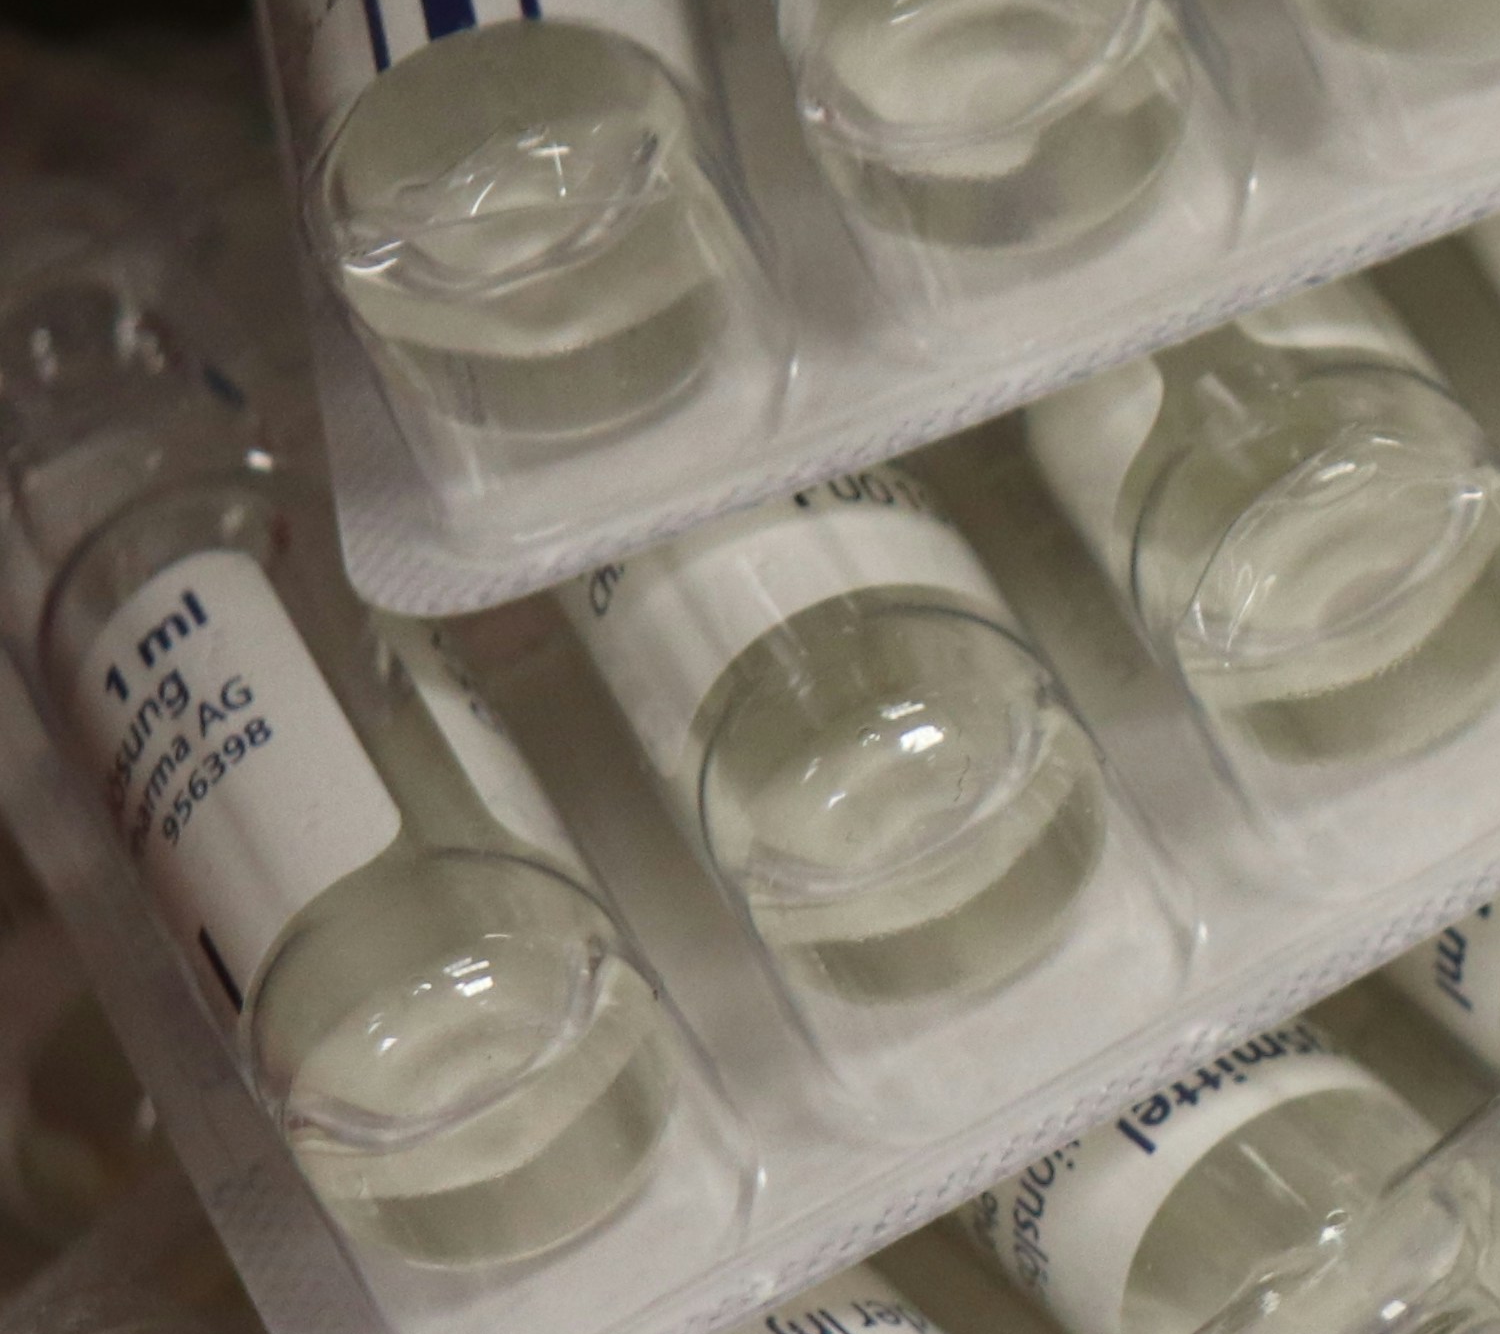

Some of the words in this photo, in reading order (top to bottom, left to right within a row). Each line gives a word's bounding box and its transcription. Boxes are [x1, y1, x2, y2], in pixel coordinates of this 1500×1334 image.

[104, 664, 131, 703] 1
[136, 588, 211, 669] ml
[198, 672, 256, 738] AG
[160, 715, 276, 848] 956398
